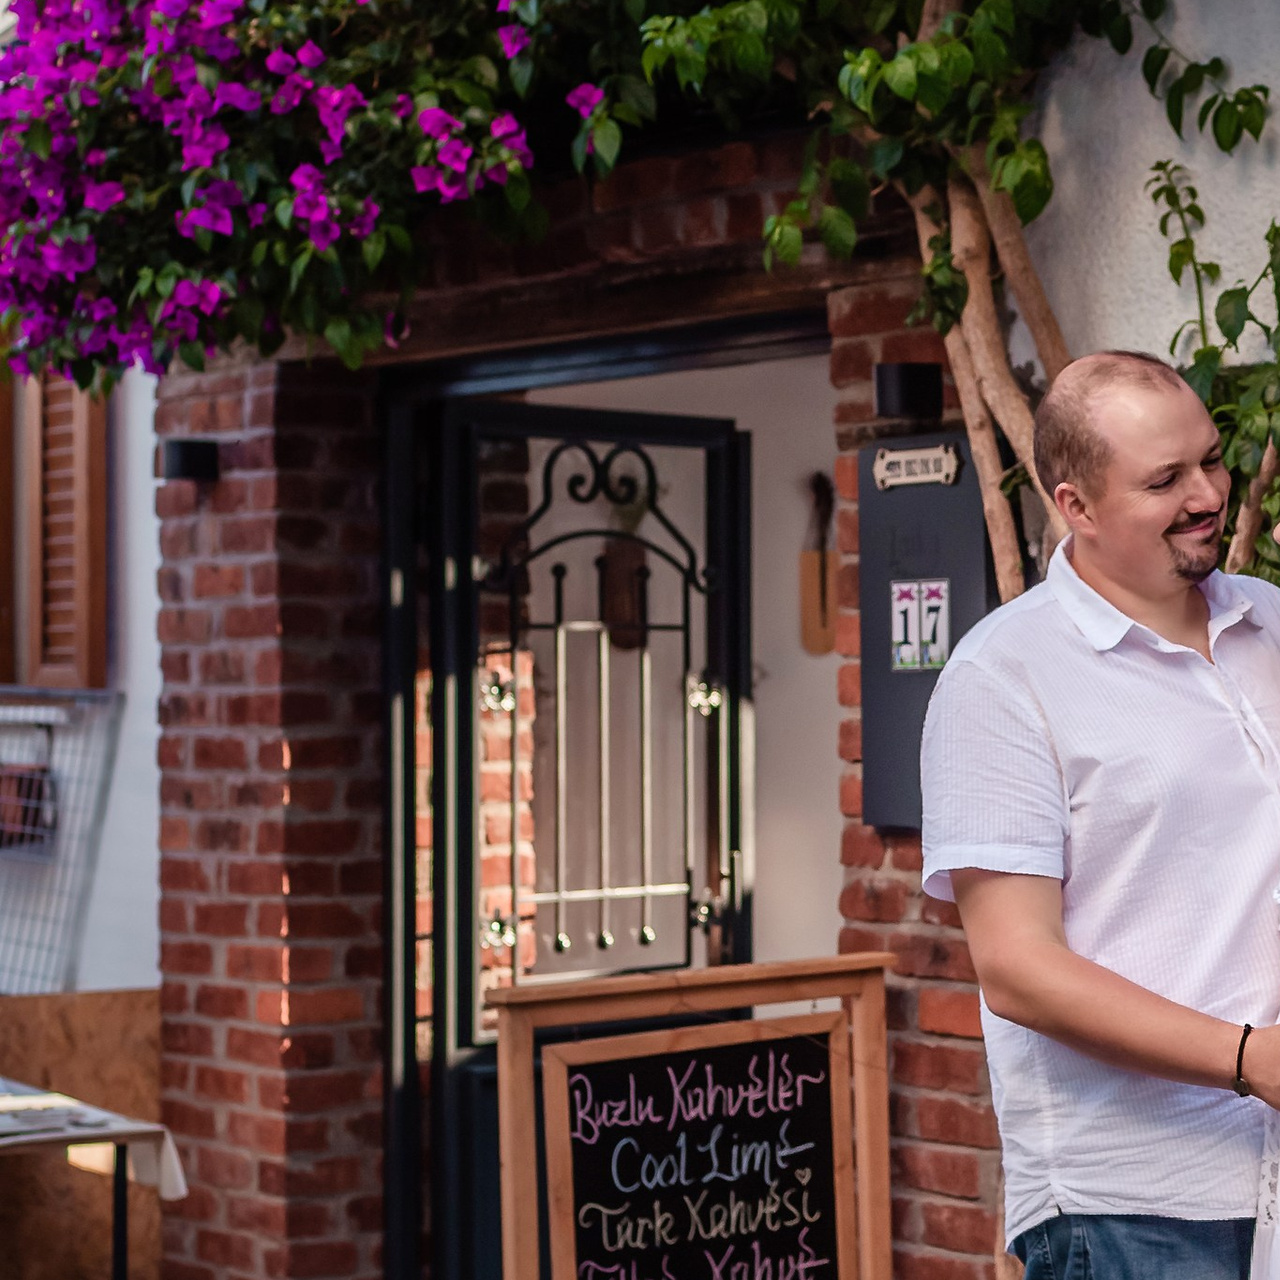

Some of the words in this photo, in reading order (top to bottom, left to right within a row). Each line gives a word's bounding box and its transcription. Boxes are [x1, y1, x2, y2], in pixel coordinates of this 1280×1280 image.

[898, 604, 942, 646] 17
[568, 1073, 664, 1145] Buzlu
[667, 1048, 826, 1132] Kahveler
[611, 1131, 697, 1193] Cool
[696, 1118, 816, 1187] Lime
[683, 1170, 821, 1242] Kahvesi
